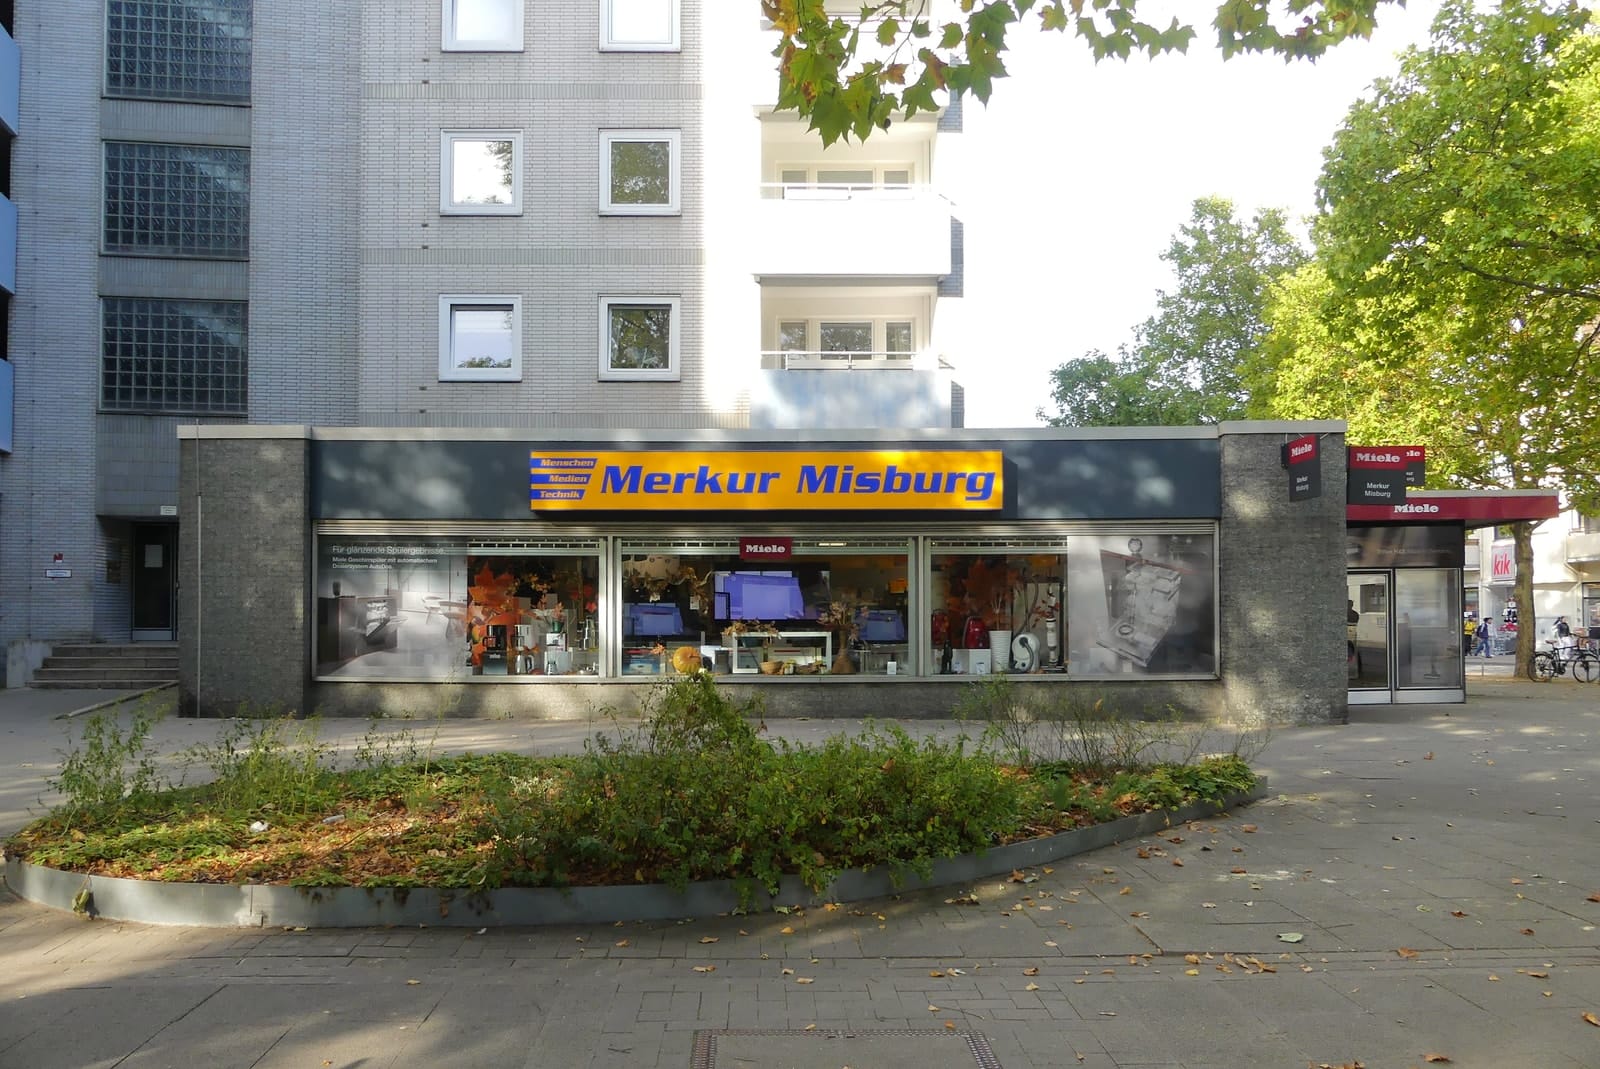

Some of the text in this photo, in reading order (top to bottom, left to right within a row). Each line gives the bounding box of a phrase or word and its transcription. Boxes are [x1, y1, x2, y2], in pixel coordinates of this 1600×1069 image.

[1291, 443, 1313, 457] Miele
[1356, 453, 1401, 463] Miele
[541, 459, 594, 467] Menschen
[549, 474, 587, 482] Medien
[600, 465, 996, 501] Merkur Misburg
[540, 490, 579, 498] Technik
[1364, 490, 1391, 499] Misburg
[1394, 503, 1440, 513] Miele
[745, 544, 786, 553] Miele
